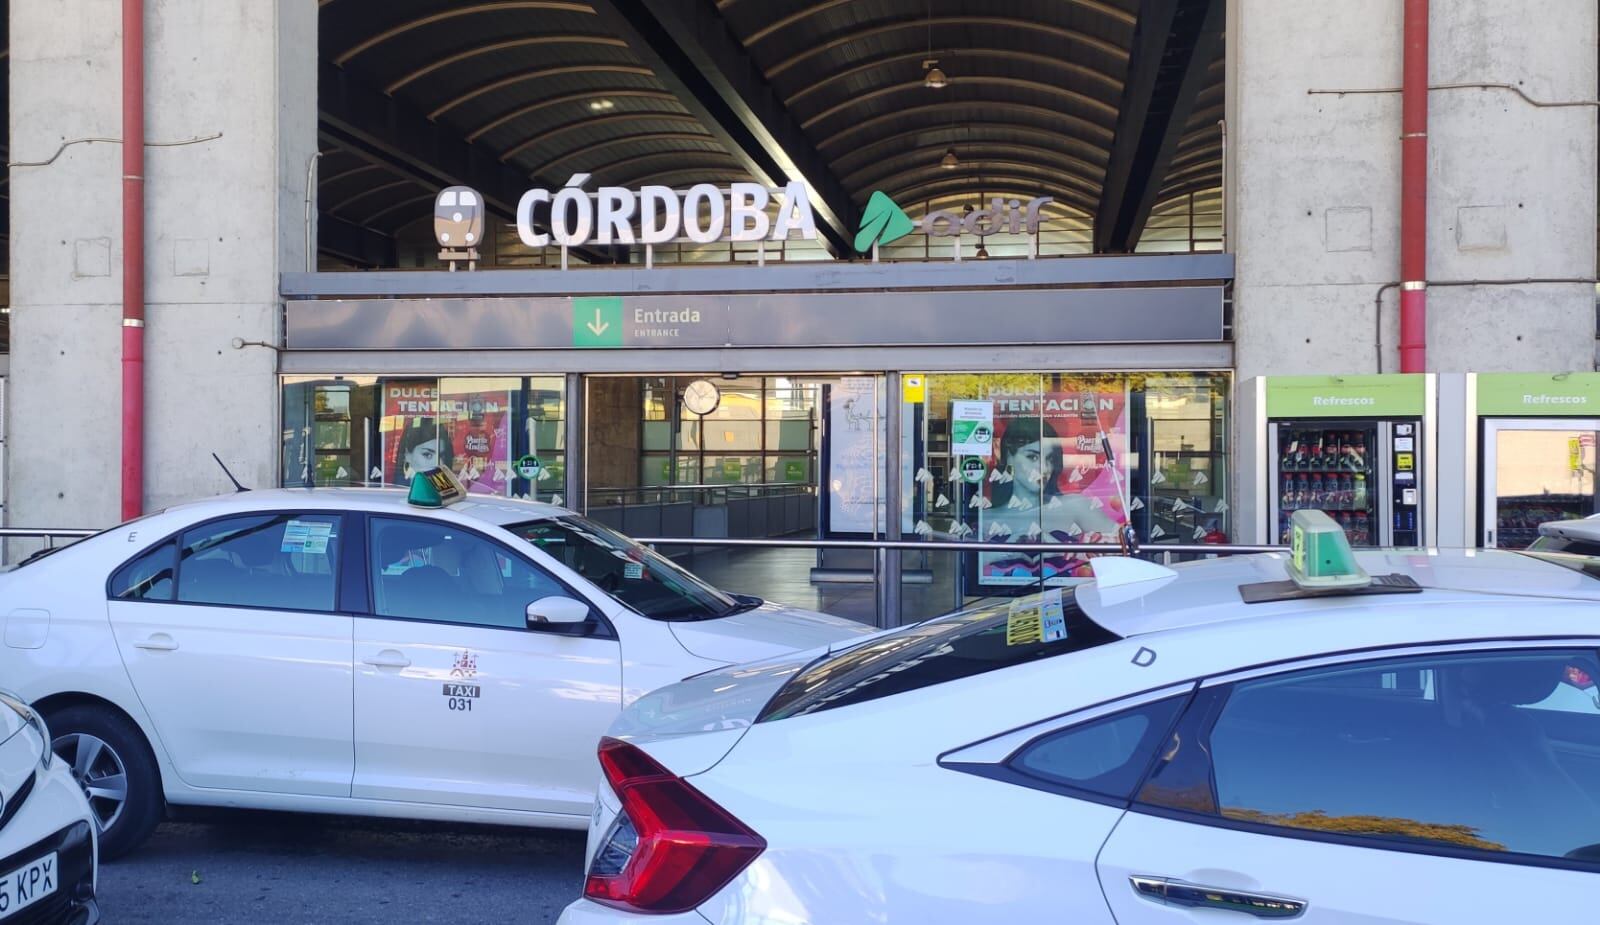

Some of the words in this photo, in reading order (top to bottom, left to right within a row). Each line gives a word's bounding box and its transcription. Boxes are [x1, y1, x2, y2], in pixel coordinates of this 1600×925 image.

[516, 173, 817, 247] CÓRDOBA
[922, 197, 1053, 237] adif
[634, 308, 701, 323] Entrada
[634, 328, 680, 337] ENTRANCE
[390, 387, 438, 399] DULCE
[988, 384, 1045, 397] DULCE
[1312, 395, 1375, 406] Refrescos
[1523, 394, 1587, 405] Refrescos
[128, 531, 138, 542] E
[1130, 646, 1157, 668] D
[447, 685, 476, 698] TAXI
[448, 697, 472, 711] 031
[17, 859, 53, 904] KPX
